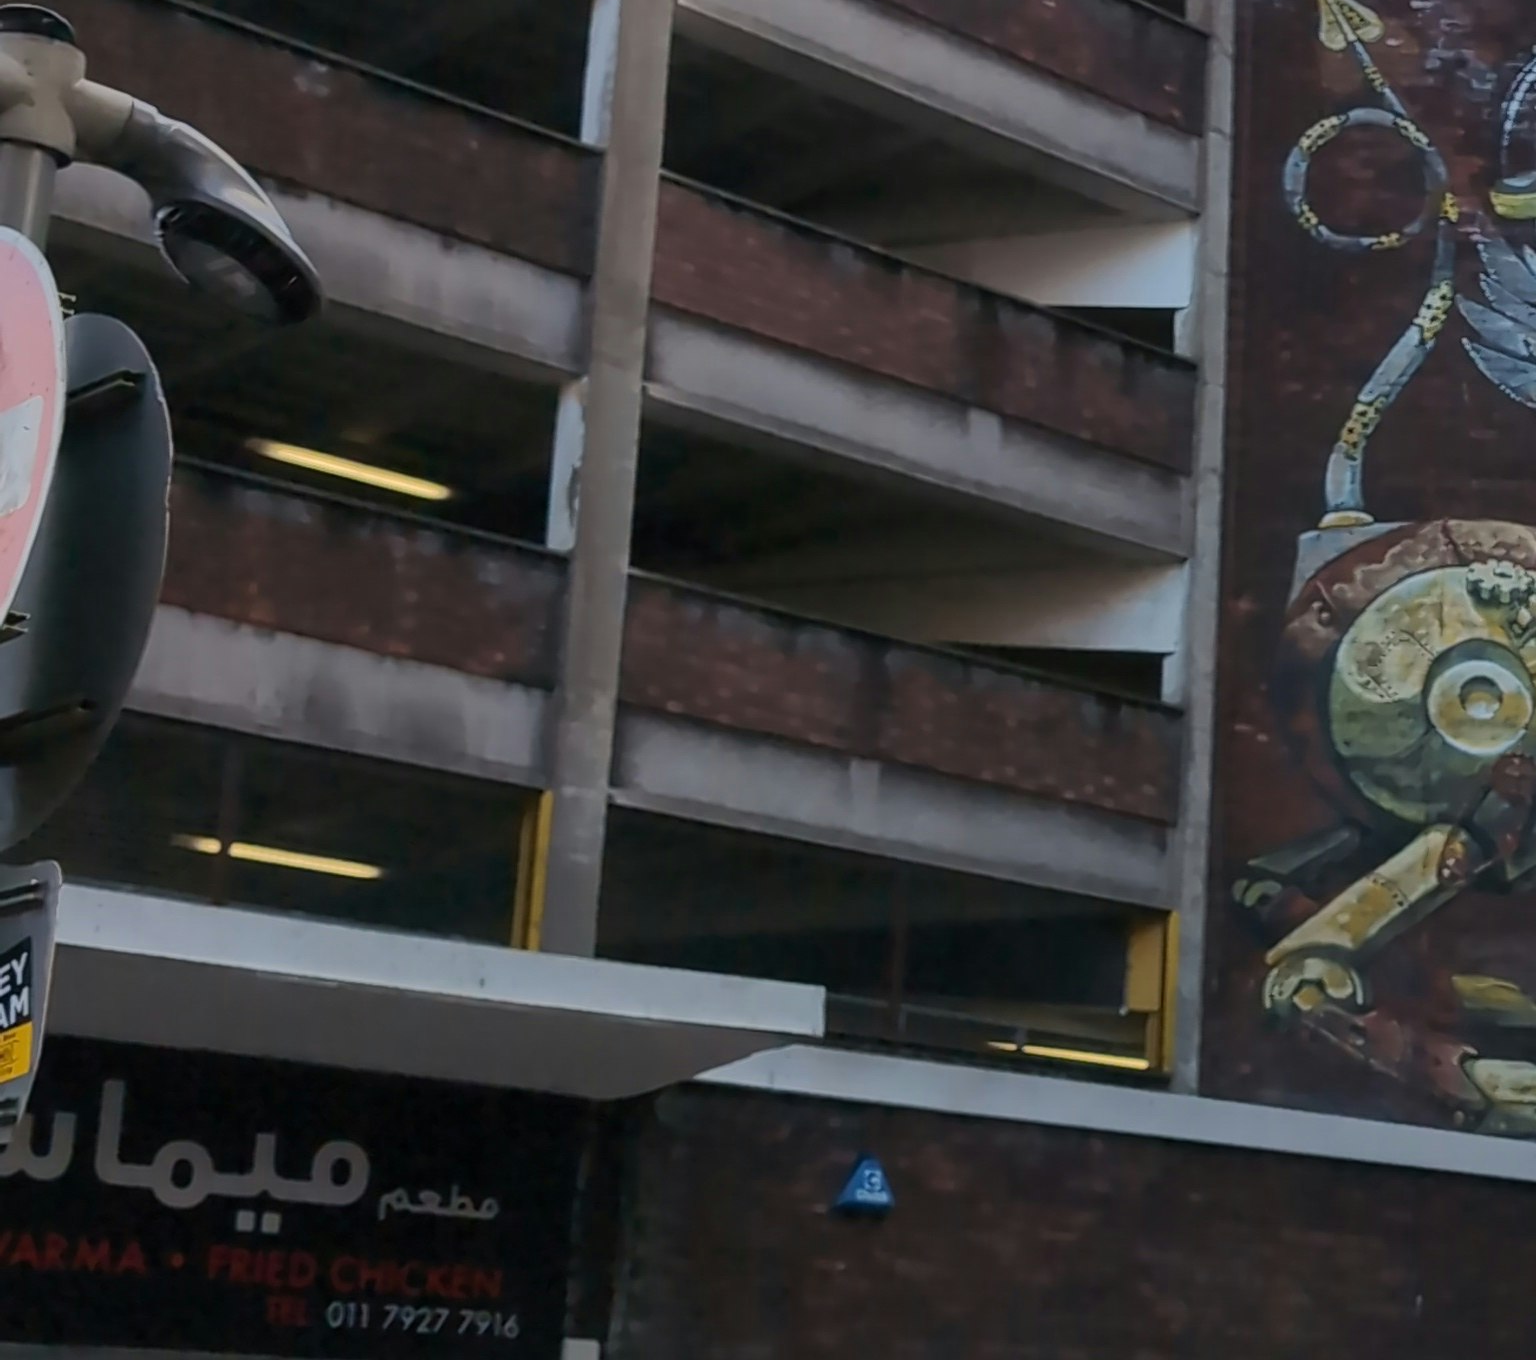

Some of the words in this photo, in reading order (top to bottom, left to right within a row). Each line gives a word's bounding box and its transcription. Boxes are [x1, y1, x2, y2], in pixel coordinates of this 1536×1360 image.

[207, 1245, 317, 1287] FRIED
[330, 1256, 504, 1299] CHICKEN
[381, 1305, 450, 1334] 7927
[457, 1309, 520, 1338] 7916
